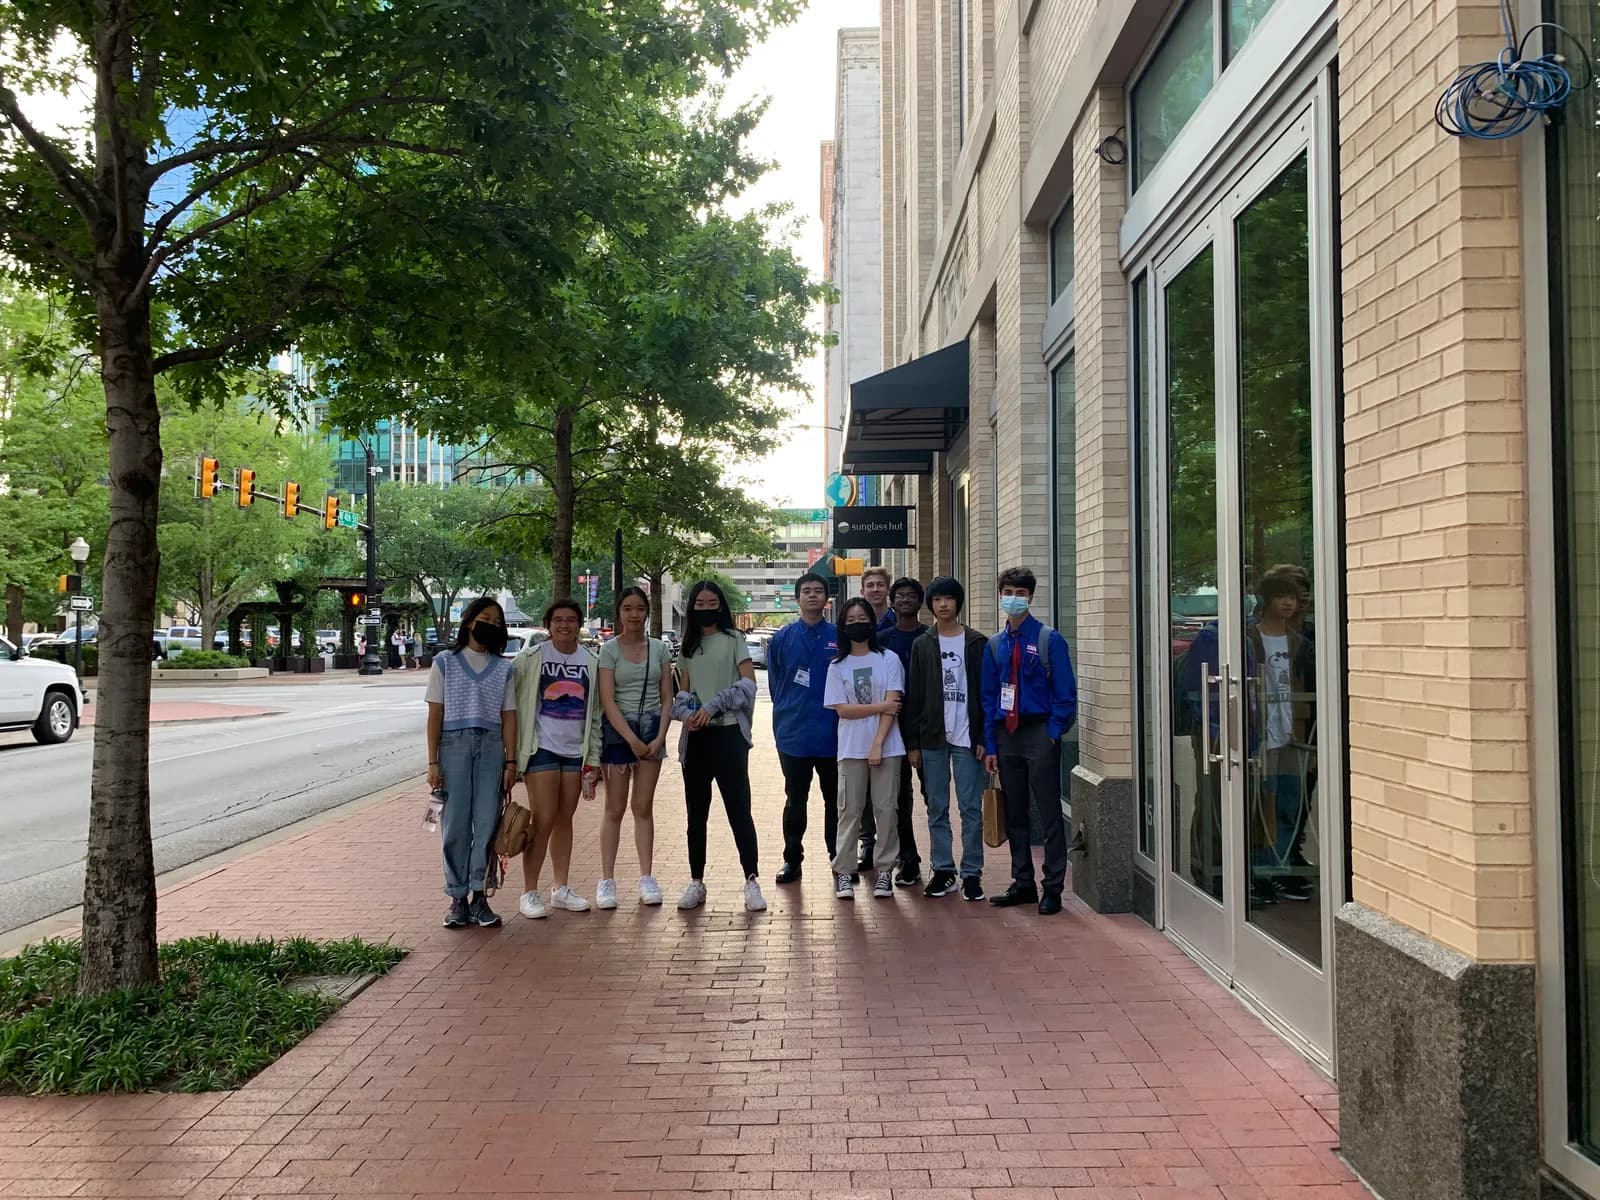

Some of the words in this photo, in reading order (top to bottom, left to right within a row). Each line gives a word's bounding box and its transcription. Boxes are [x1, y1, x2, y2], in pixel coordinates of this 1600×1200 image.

[851, 522, 888, 533] sunglass
[888, 521, 903, 531] hut
[541, 663, 590, 679] NASA
